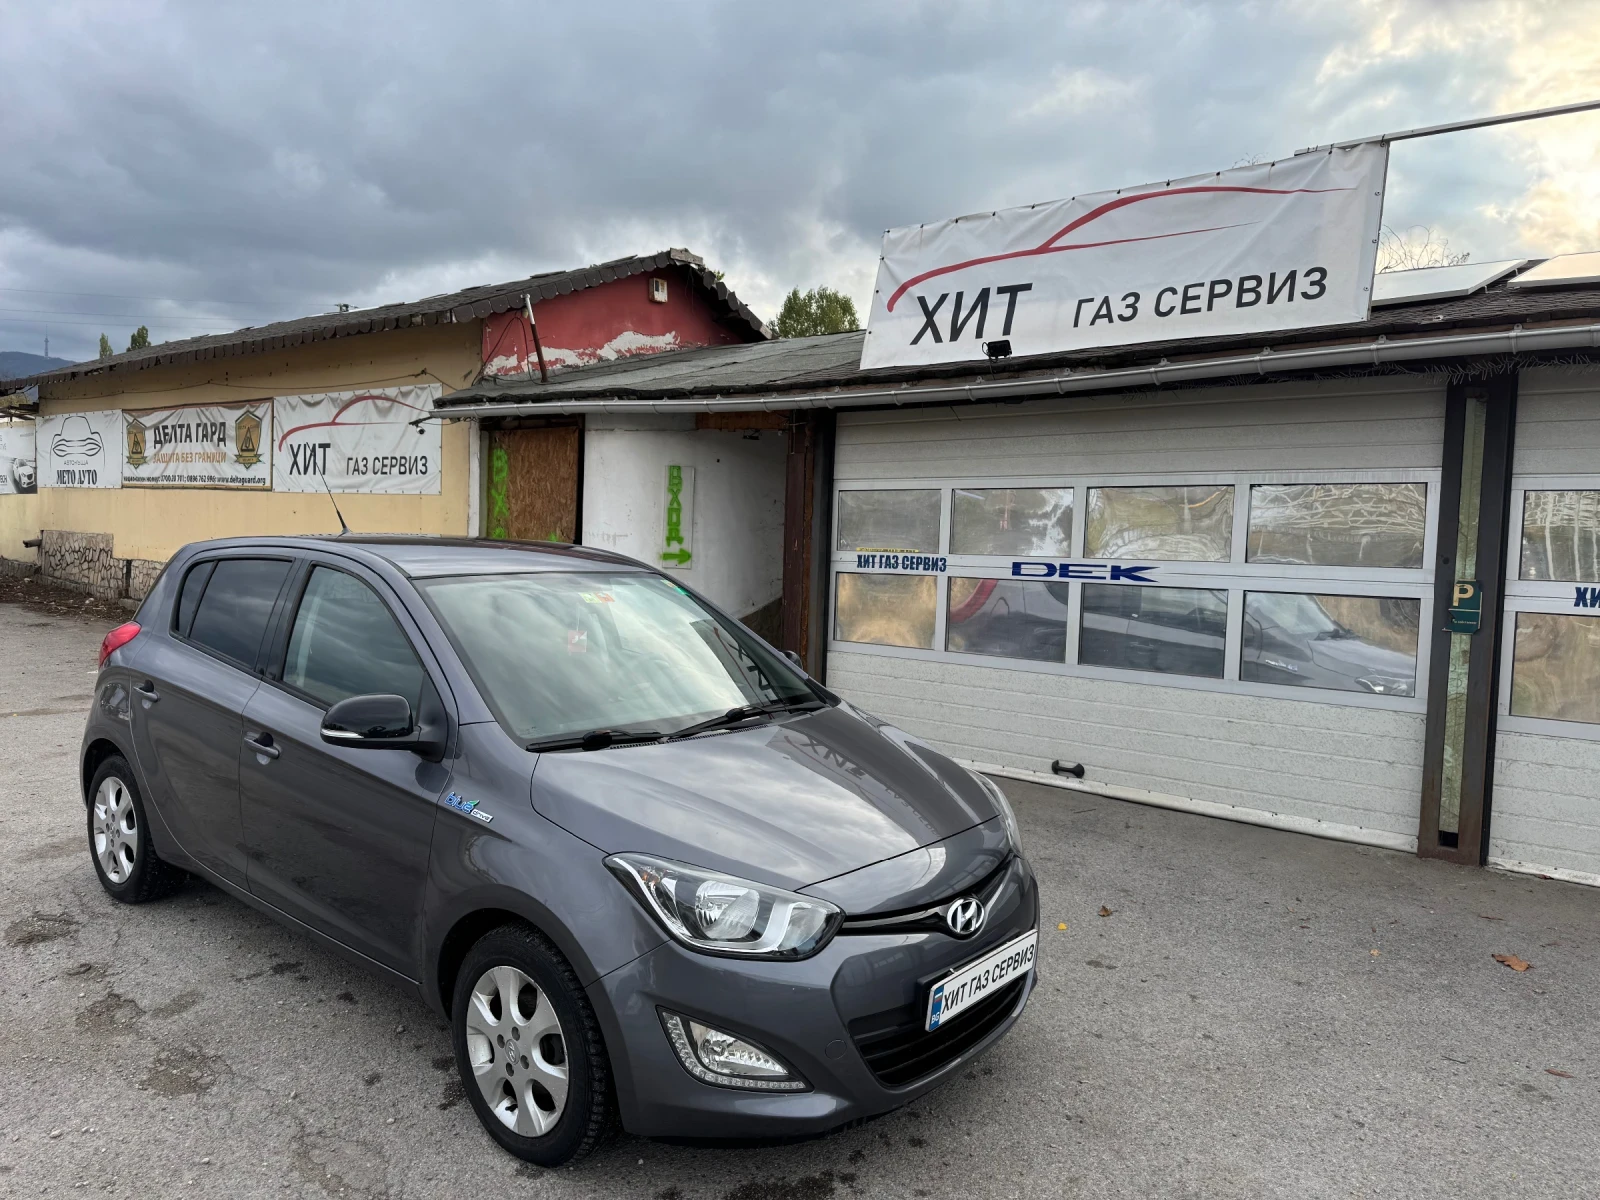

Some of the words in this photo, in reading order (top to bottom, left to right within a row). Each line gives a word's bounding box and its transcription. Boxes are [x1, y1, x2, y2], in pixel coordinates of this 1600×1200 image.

[910, 283, 1033, 345] ХИТ
[1073, 292, 1139, 328] ГАЗ
[1153, 266, 1329, 317] СЕРВИЗ
[154, 423, 192, 449] ДЕЛТА
[196, 422, 226, 447] ГАРД
[153, 452, 180, 464] ЗАЩИТА
[181, 452, 193, 463] БЕЗ
[195, 452, 227, 464] ГРАНИЦИ
[289, 443, 331, 475] ХИТ
[346, 457, 368, 475] ГАЗ
[372, 456, 428, 475] СЕРВИЗ
[77, 469, 97, 485] АУТО
[857, 555, 876, 568] ХИТ
[879, 555, 899, 570] ГАЗ
[902, 556, 947, 572] СЕРВИЗ
[1012, 561, 1160, 582] DEK
[1453, 584, 1474, 606] P
[445, 791, 474, 814] blue
[942, 982, 968, 1014] ХИТ
[968, 969, 990, 998] ГАЗ
[991, 943, 1035, 983] СЕРВИЗ
[931, 1012, 940, 1024] BG
